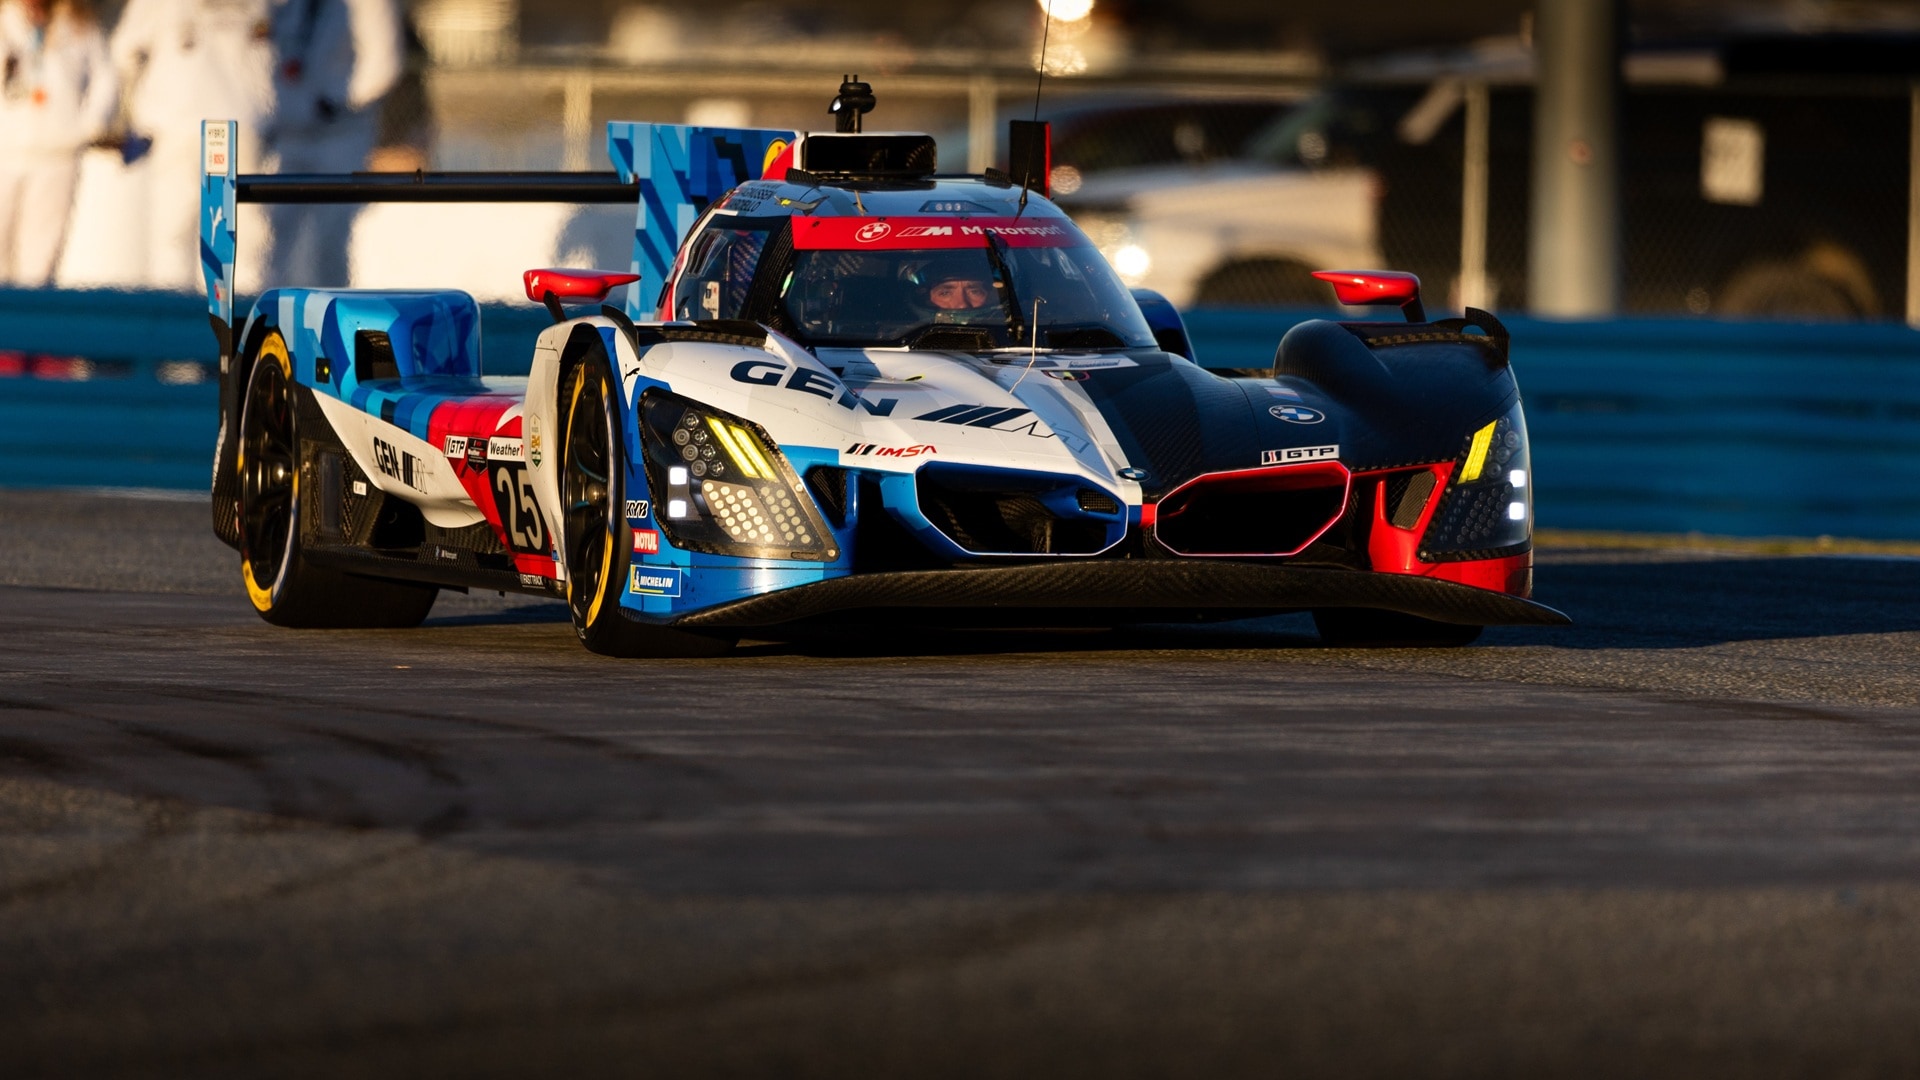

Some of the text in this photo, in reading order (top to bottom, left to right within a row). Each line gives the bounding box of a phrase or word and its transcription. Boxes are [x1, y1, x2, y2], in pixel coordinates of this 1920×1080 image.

[961, 226, 1065, 237] Motorsport
[730, 360, 899, 417] GEN
[449, 439, 466, 454] GTP
[875, 444, 938, 458] IMSA
[1286, 447, 1335, 459] GTP
[373, 436, 401, 482] GEN
[497, 467, 543, 551] 25
[626, 501, 648, 518] KYB
[633, 532, 658, 551] MOTUL
[640, 575, 674, 588] MICHELIN
